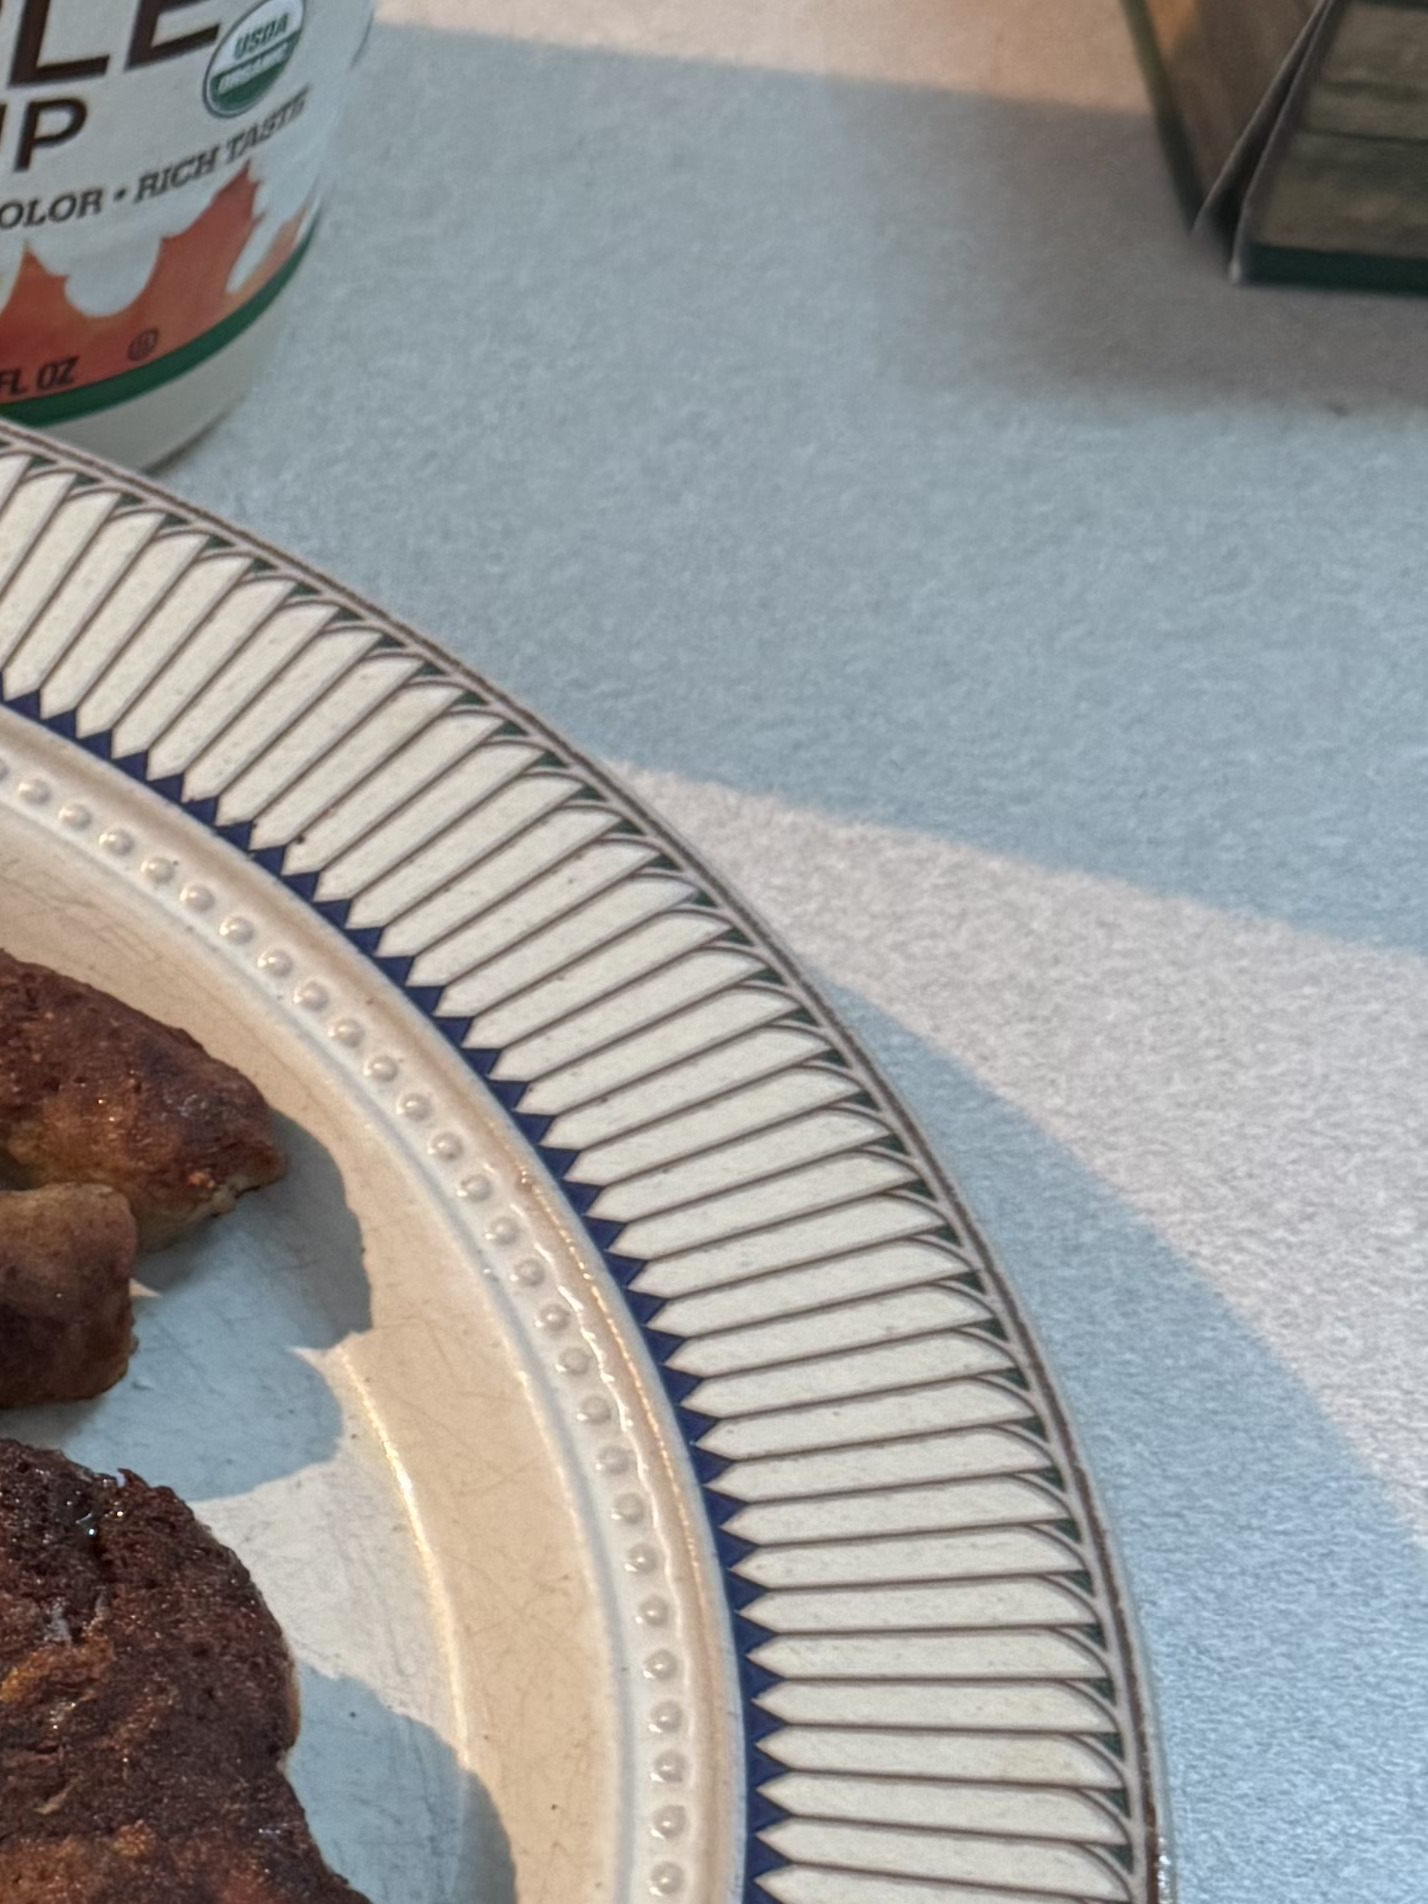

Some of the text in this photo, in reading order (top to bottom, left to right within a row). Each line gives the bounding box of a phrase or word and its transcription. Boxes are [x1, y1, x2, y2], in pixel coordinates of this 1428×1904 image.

[233, 12, 290, 61] USDA
[132, 149, 220, 205] RICH
[35, 354, 81, 392] OZ
